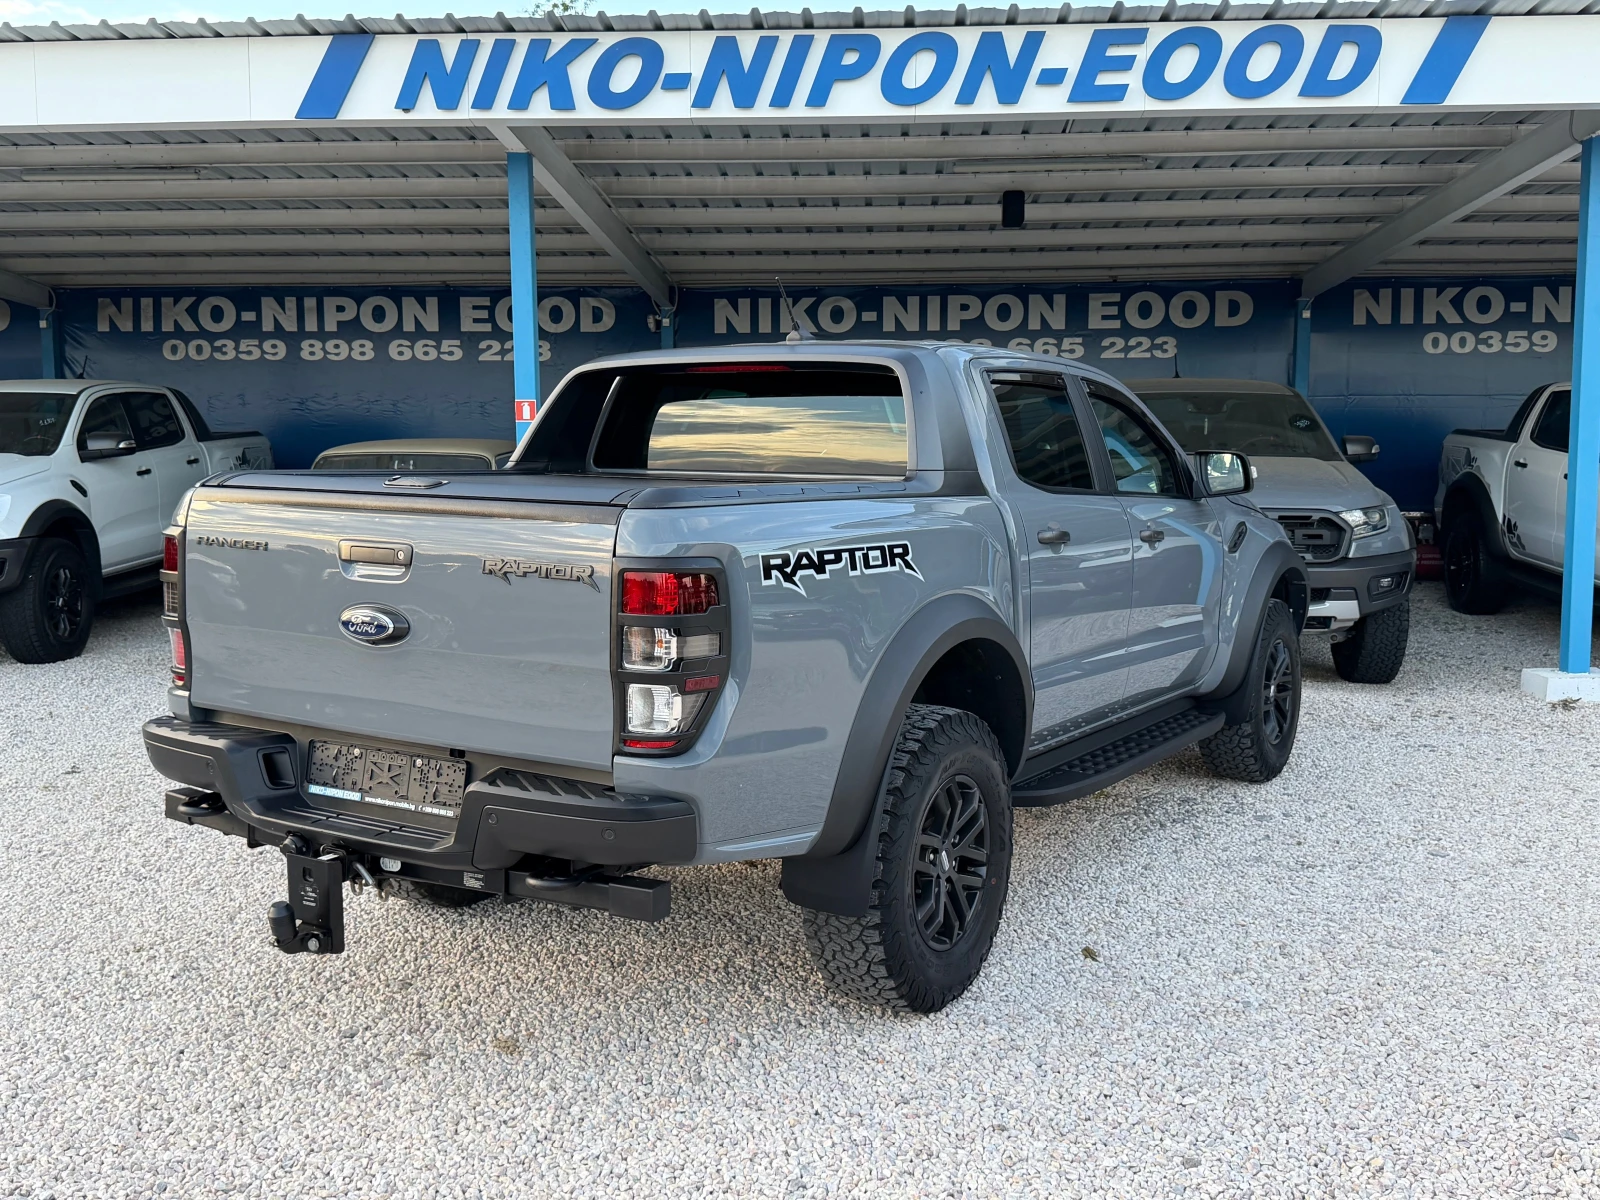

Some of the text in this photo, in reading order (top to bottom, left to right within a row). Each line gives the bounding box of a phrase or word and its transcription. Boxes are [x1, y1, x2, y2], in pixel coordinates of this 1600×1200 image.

[394, 24, 1382, 110] NIKO-NIPON-EOOD
[97, 295, 439, 333] NIKO-NIPON
[714, 290, 1254, 334] NIKO-NIPON EOOD
[162, 339, 287, 361] 00359
[300, 339, 375, 361] 898
[388, 339, 463, 361] 665
[1100, 336, 1178, 359] 223
[1422, 330, 1558, 354] 00359
[196, 535, 269, 552] RANGER
[482, 558, 600, 594] RAPTOR
[758, 540, 926, 598] RAPTOR
[348, 614, 378, 634] Ford
